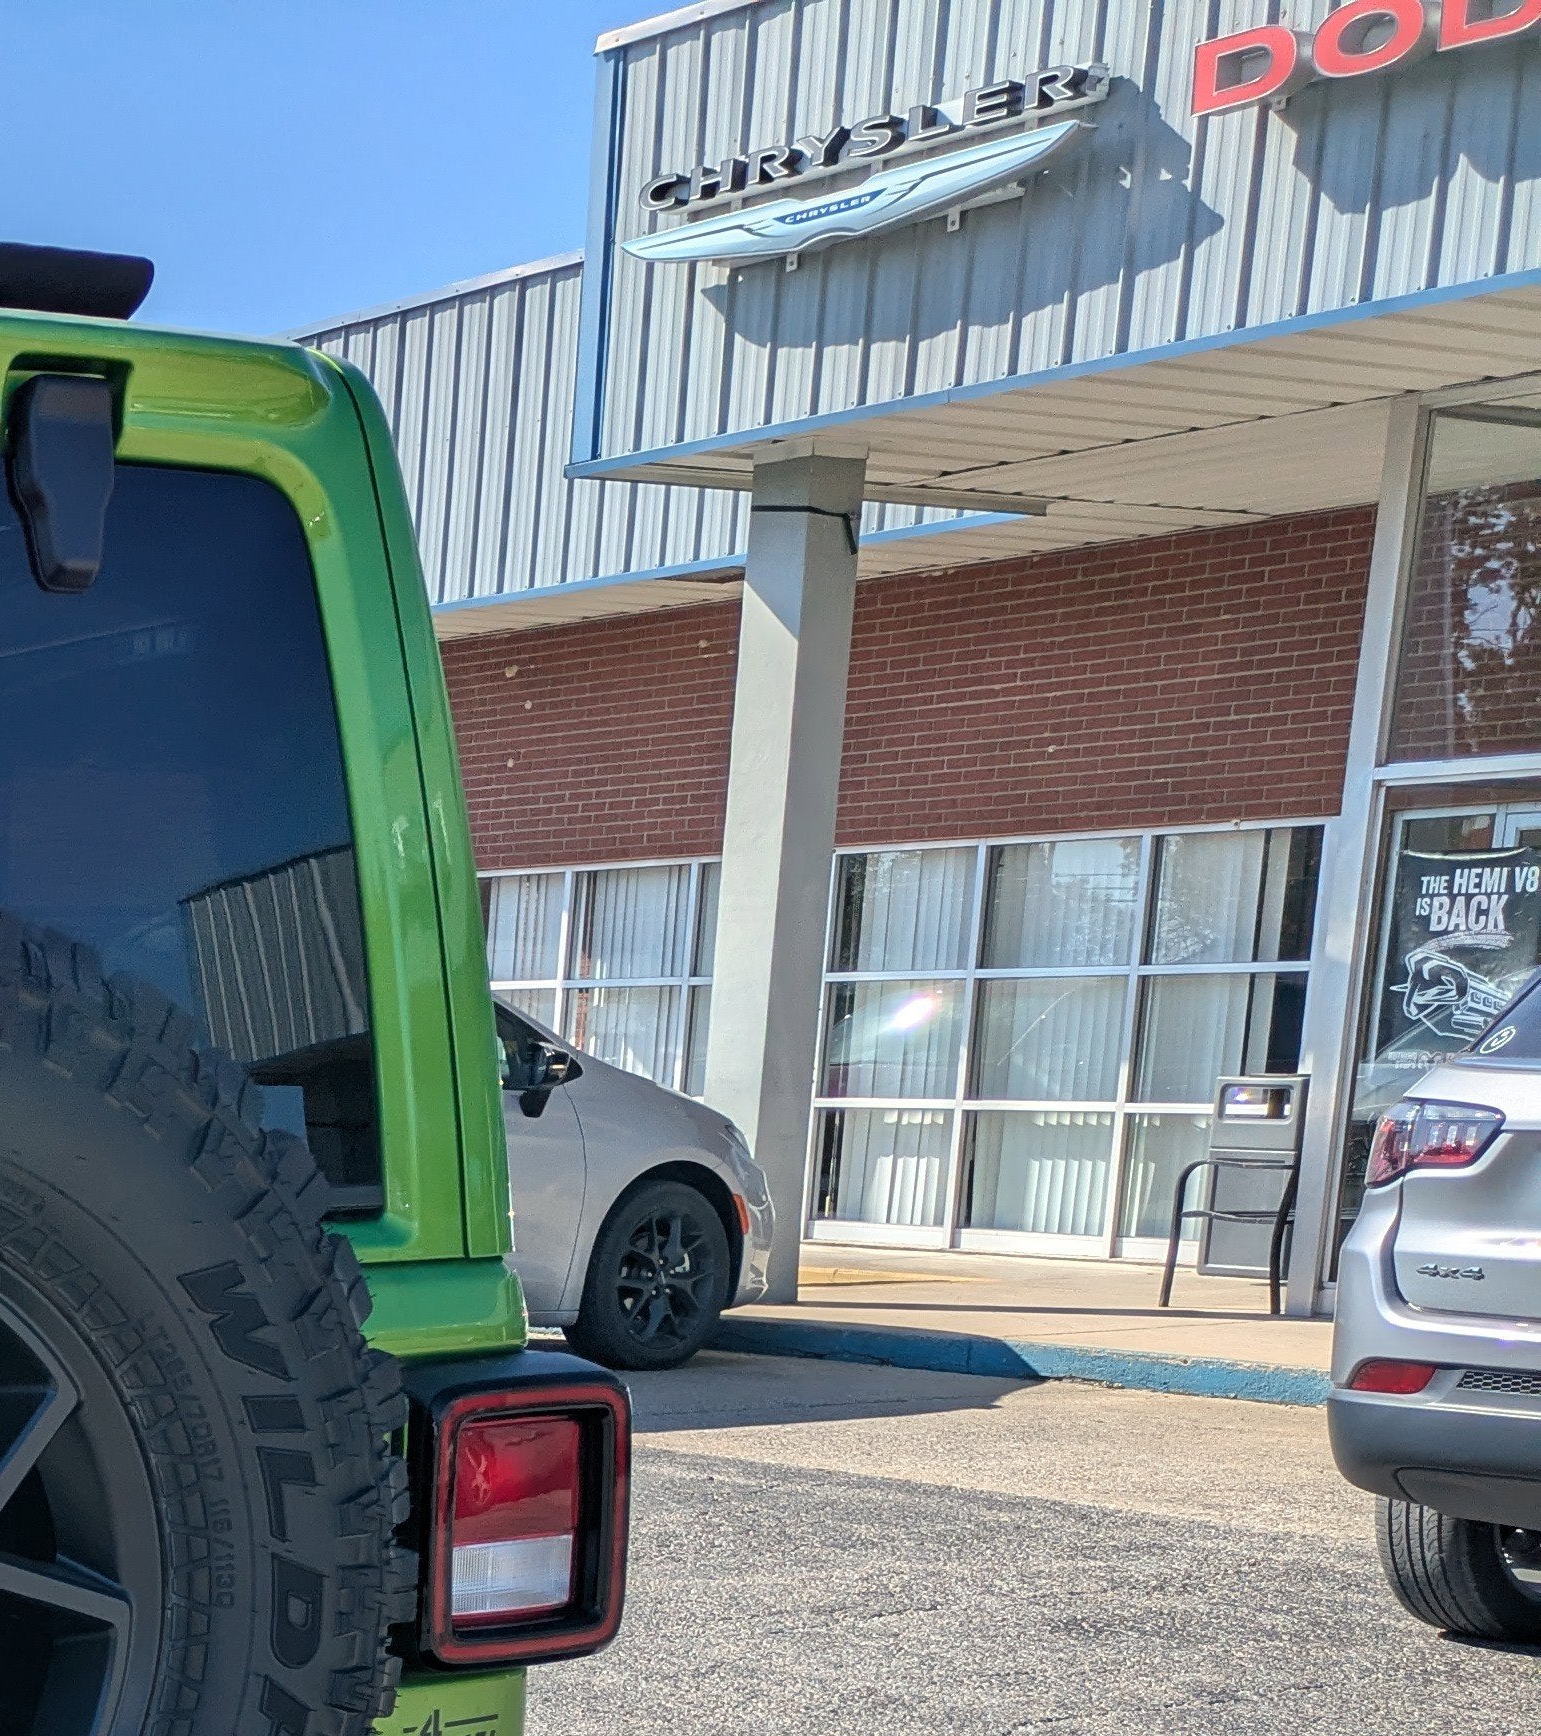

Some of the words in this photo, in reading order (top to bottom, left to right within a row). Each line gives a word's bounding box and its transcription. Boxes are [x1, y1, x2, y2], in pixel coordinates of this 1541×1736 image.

[639, 64, 1091, 212] CHRYSLER
[784, 195, 871, 224] CHRYSLER
[1420, 875, 1449, 894] THE
[1453, 868, 1512, 893] HEMI
[1514, 865, 1539, 893] V8
[1416, 897, 1430, 916] IS
[1429, 894, 1509, 932] BACK
